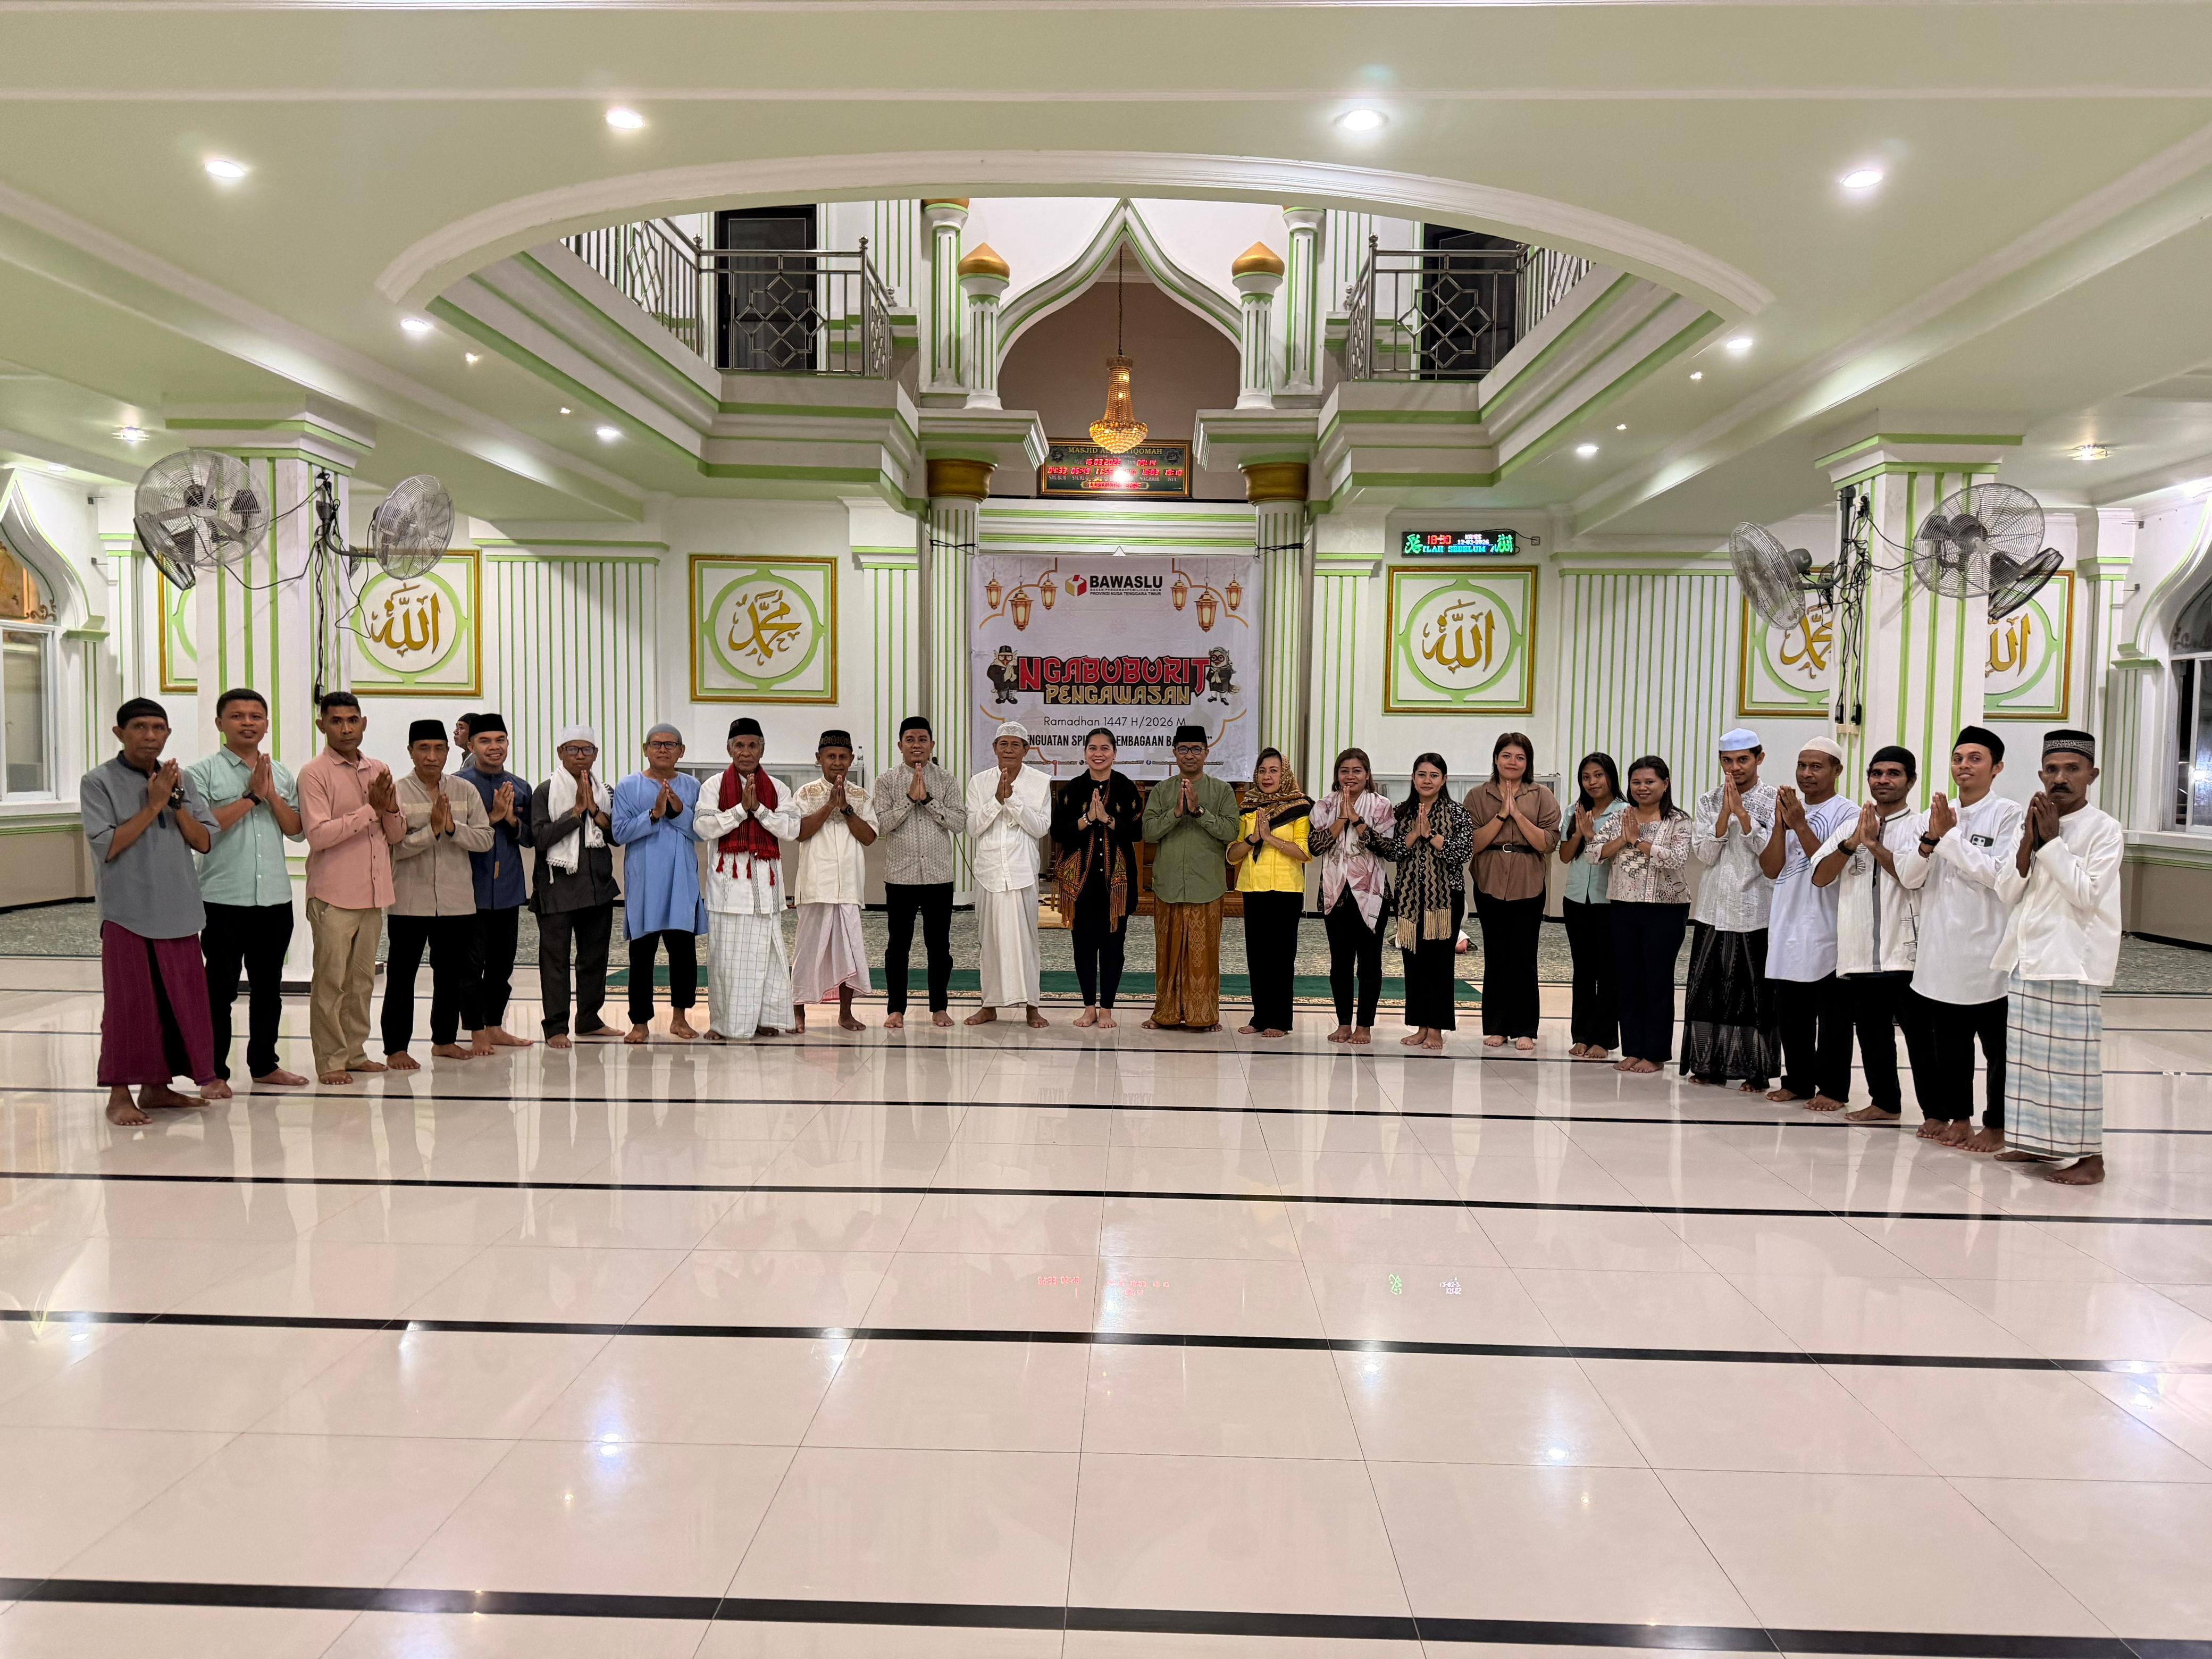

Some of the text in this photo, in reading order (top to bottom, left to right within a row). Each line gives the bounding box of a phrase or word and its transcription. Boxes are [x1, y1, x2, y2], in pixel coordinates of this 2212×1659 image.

[1090, 575, 1163, 588] BAWASLU
[1019, 656, 1210, 694] NGABUBURIT
[1045, 684, 1189, 704] PENGAWASAN
[1044, 716, 1186, 728] Ramadhan 1447 H/2026 M
[1027, 734, 1069, 746] NGUATAN
[1116, 735, 1164, 747] EMBAGAAN
